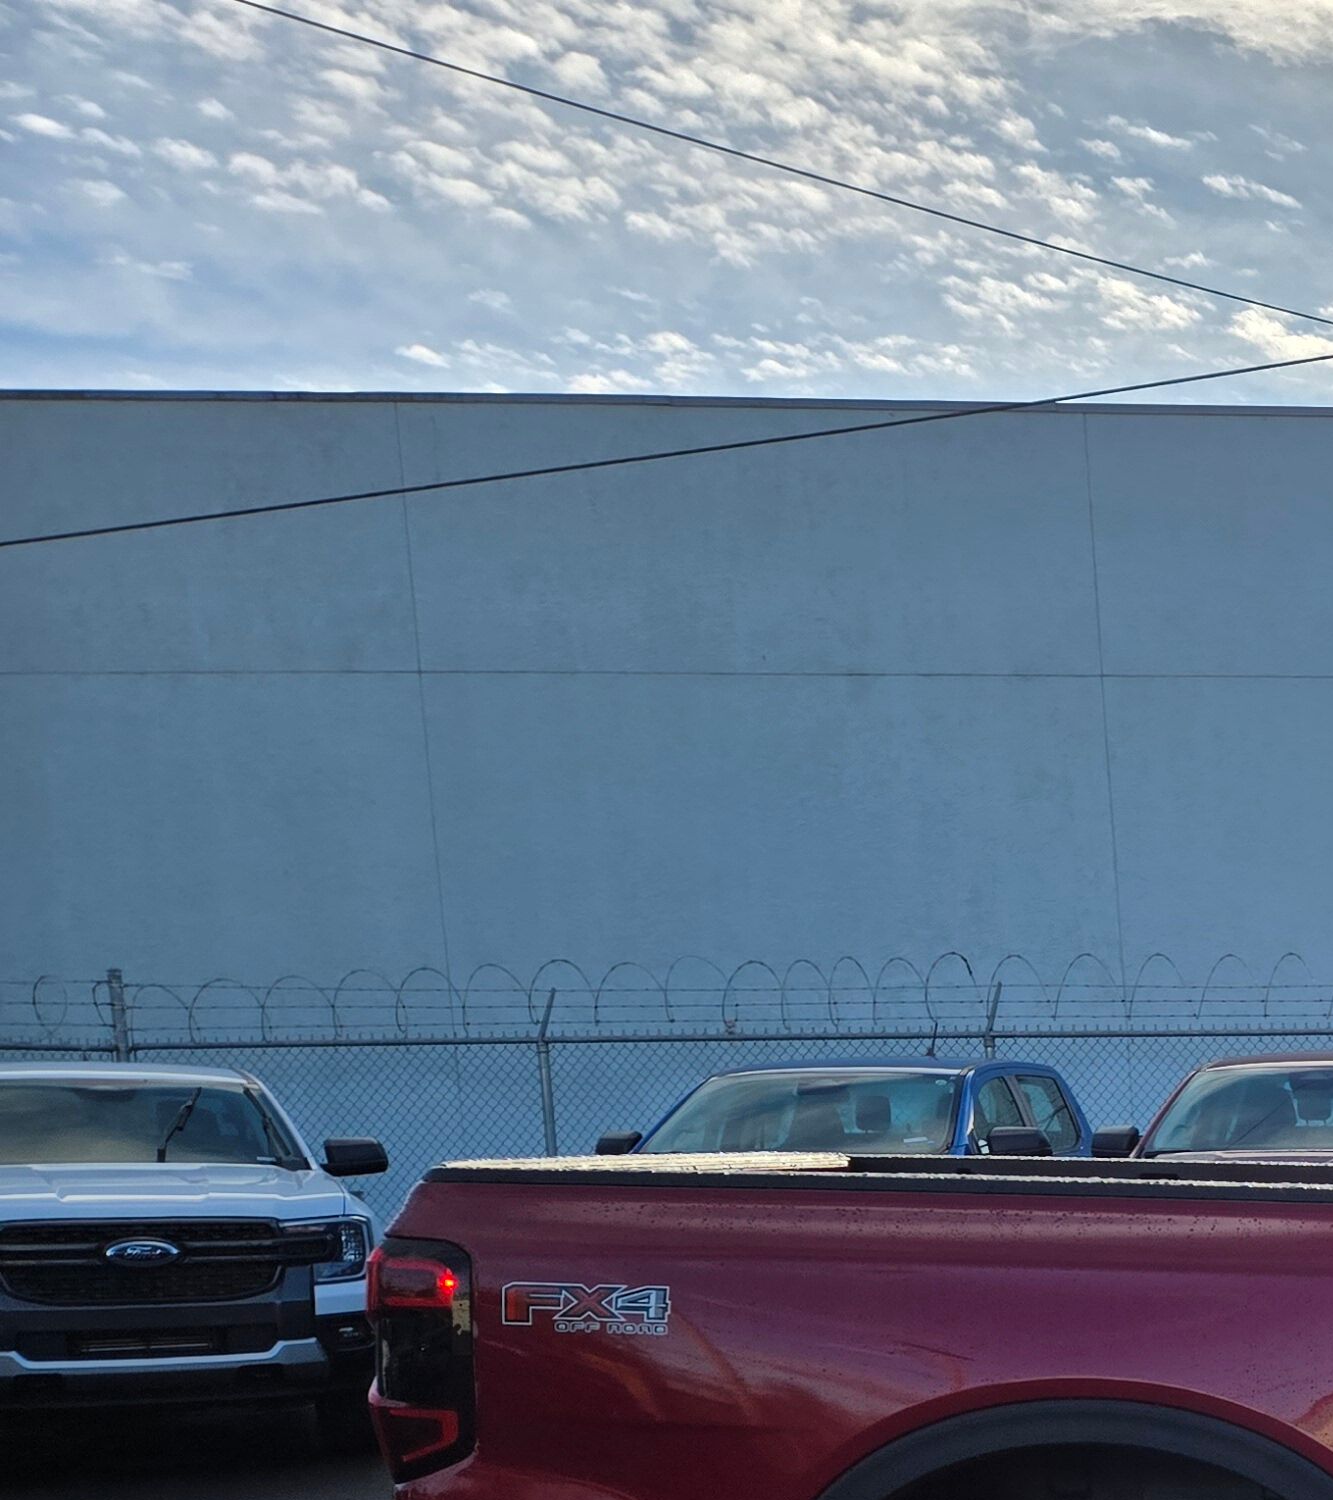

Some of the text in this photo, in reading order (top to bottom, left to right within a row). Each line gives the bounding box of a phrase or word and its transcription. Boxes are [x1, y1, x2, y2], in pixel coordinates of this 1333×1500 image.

[502, 1281, 671, 1325] FX4
[554, 1321, 668, 1335] OFF ROAD
